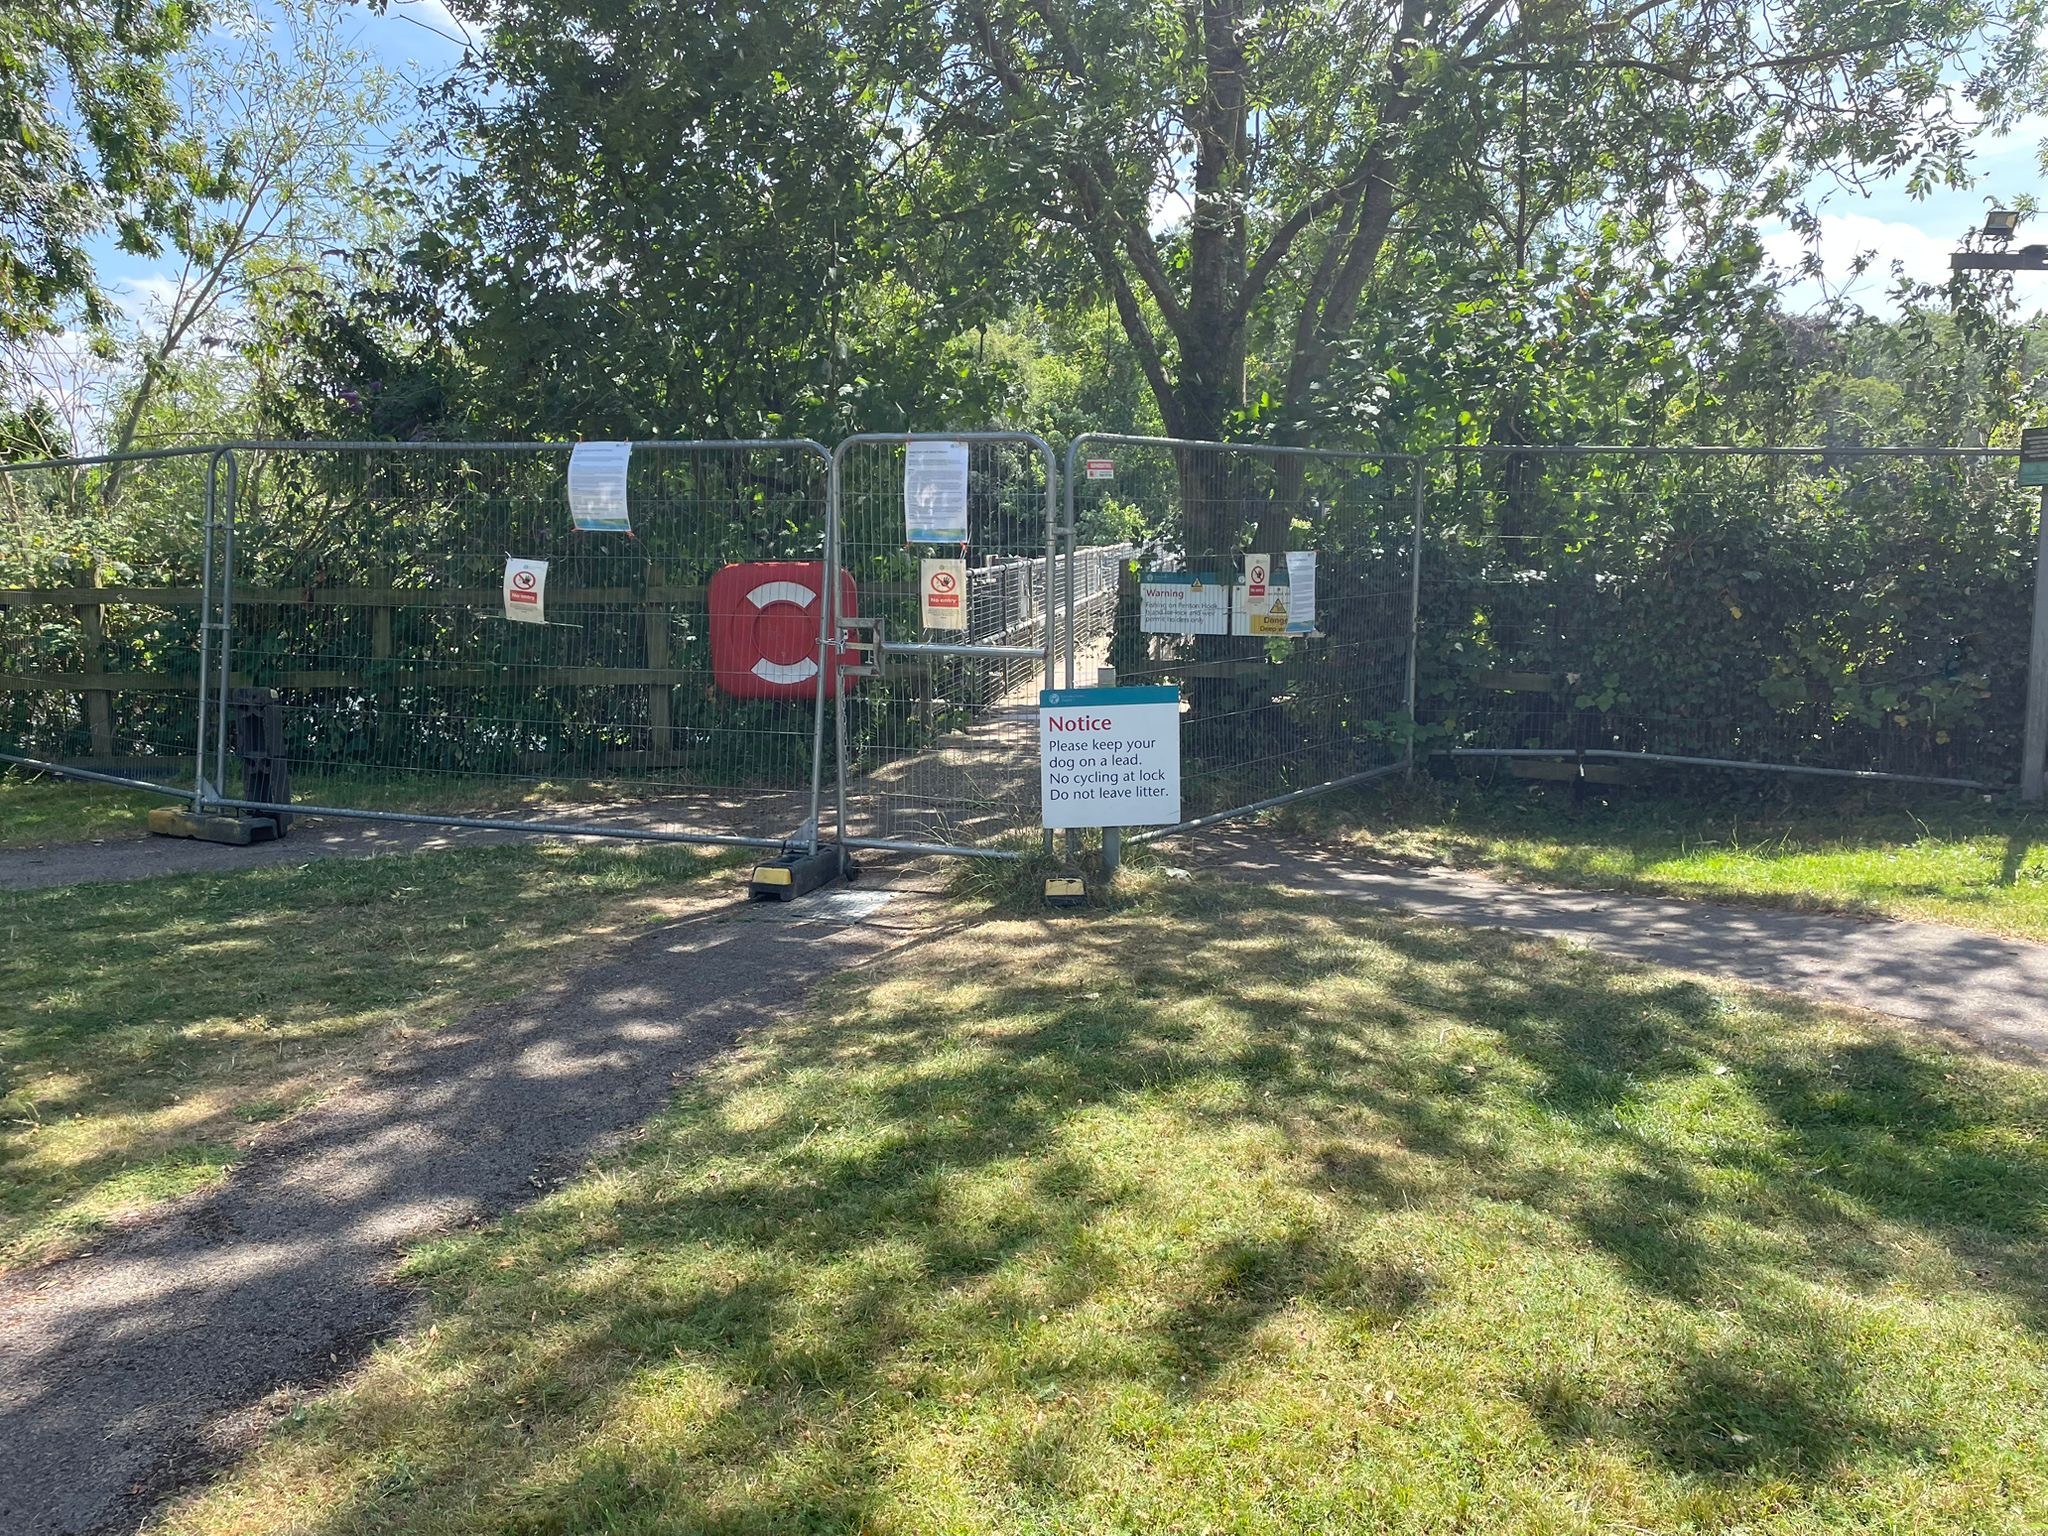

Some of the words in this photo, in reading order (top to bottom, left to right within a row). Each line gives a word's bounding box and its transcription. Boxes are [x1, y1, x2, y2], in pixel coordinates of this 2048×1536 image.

[1146, 588, 1184, 600] Warning
[1263, 616, 1289, 627] Dange
[1049, 715, 1112, 732] Notice
[1049, 740, 1088, 752] Please
[1092, 738, 1123, 753] keep
[1126, 738, 1156, 752] your
[1049, 756, 1075, 771] dog
[1079, 758, 1096, 768] on
[1100, 757, 1107, 767] a
[1112, 753, 1142, 766] lead.
[1050, 773, 1070, 784] No
[1073, 771, 1119, 787] cycling
[1122, 771, 1136, 782] at
[1139, 769, 1165, 782] lock
[1050, 789, 1069, 801] Do
[1073, 789, 1095, 800] not
[1099, 787, 1132, 799] leave
[1136, 786, 1169, 798] litter.
